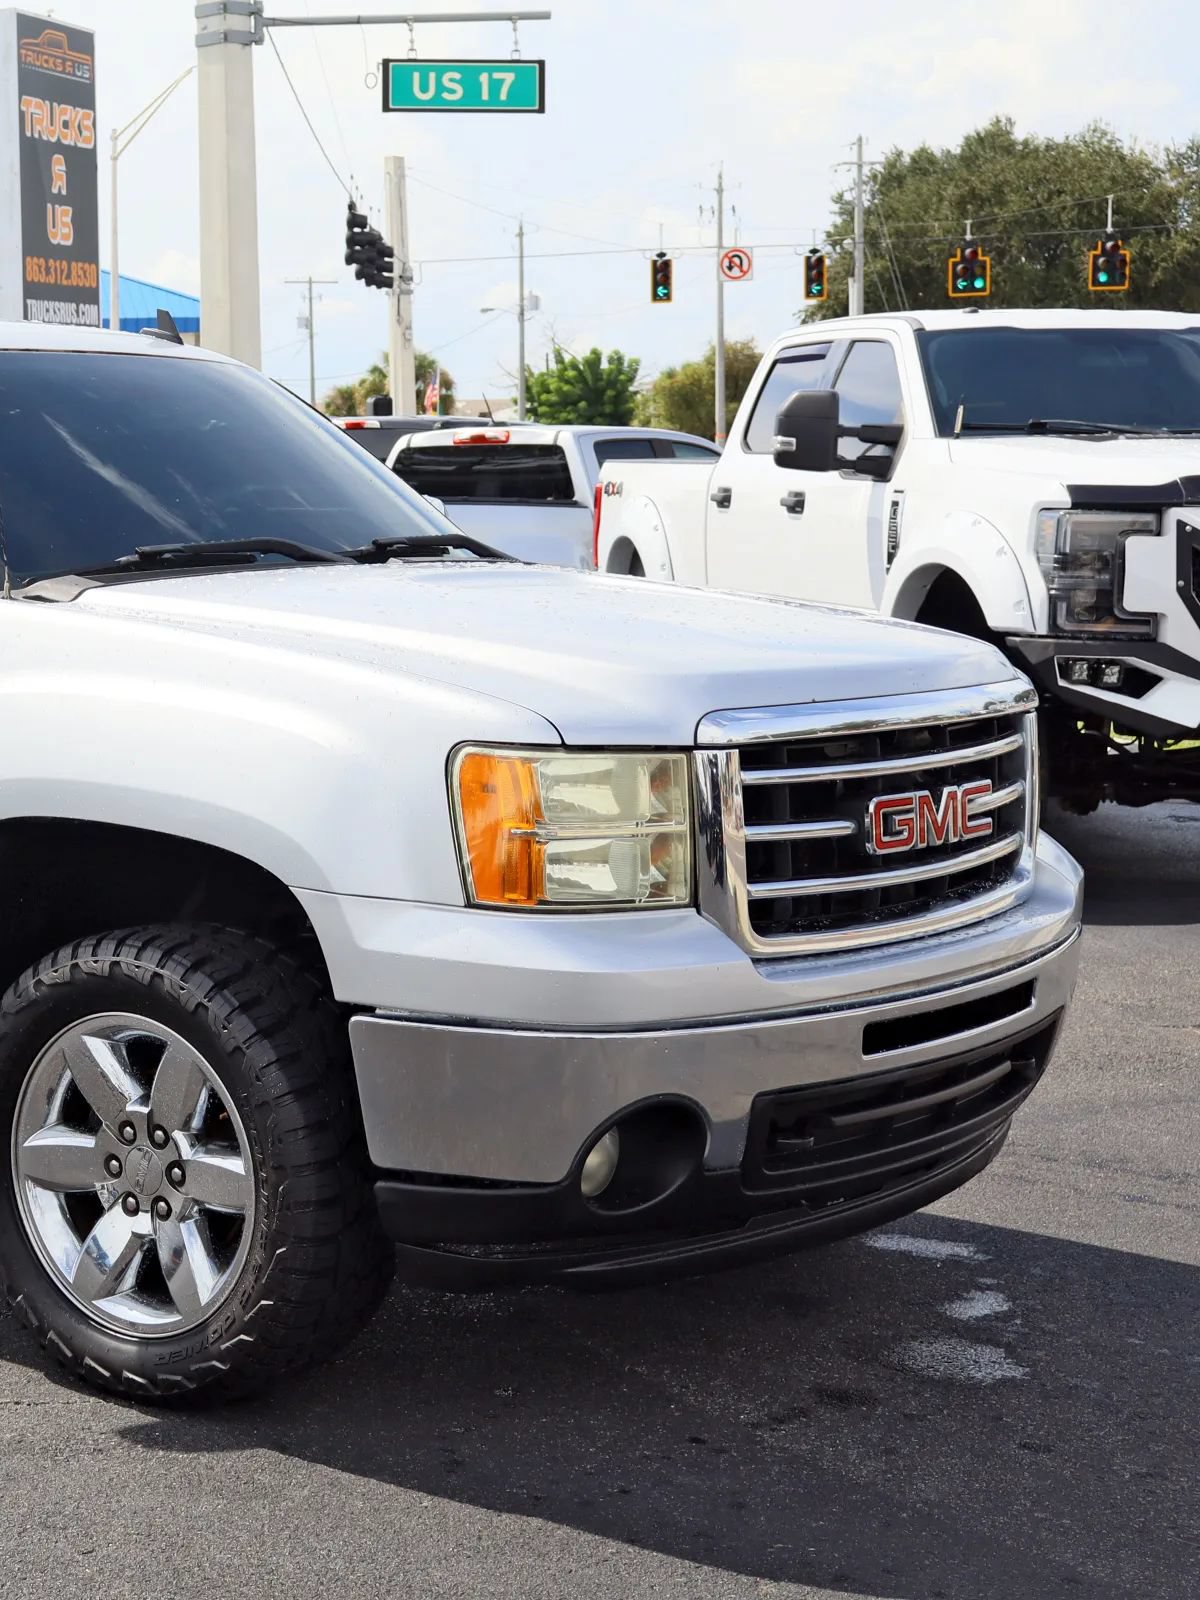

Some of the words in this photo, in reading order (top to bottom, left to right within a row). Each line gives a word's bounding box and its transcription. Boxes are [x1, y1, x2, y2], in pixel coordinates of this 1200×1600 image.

[20, 49, 63, 72] TRUCKS
[74, 62, 90, 78] US
[413, 71, 464, 101] US
[479, 72, 516, 101] 17
[21, 96, 94, 149] TRUCKS
[46, 202, 73, 246] US
[25, 256, 97, 288] 863.312.8530
[26, 299, 98, 325] TRUCKSRUS.COM
[865, 779, 993, 856] GMC
